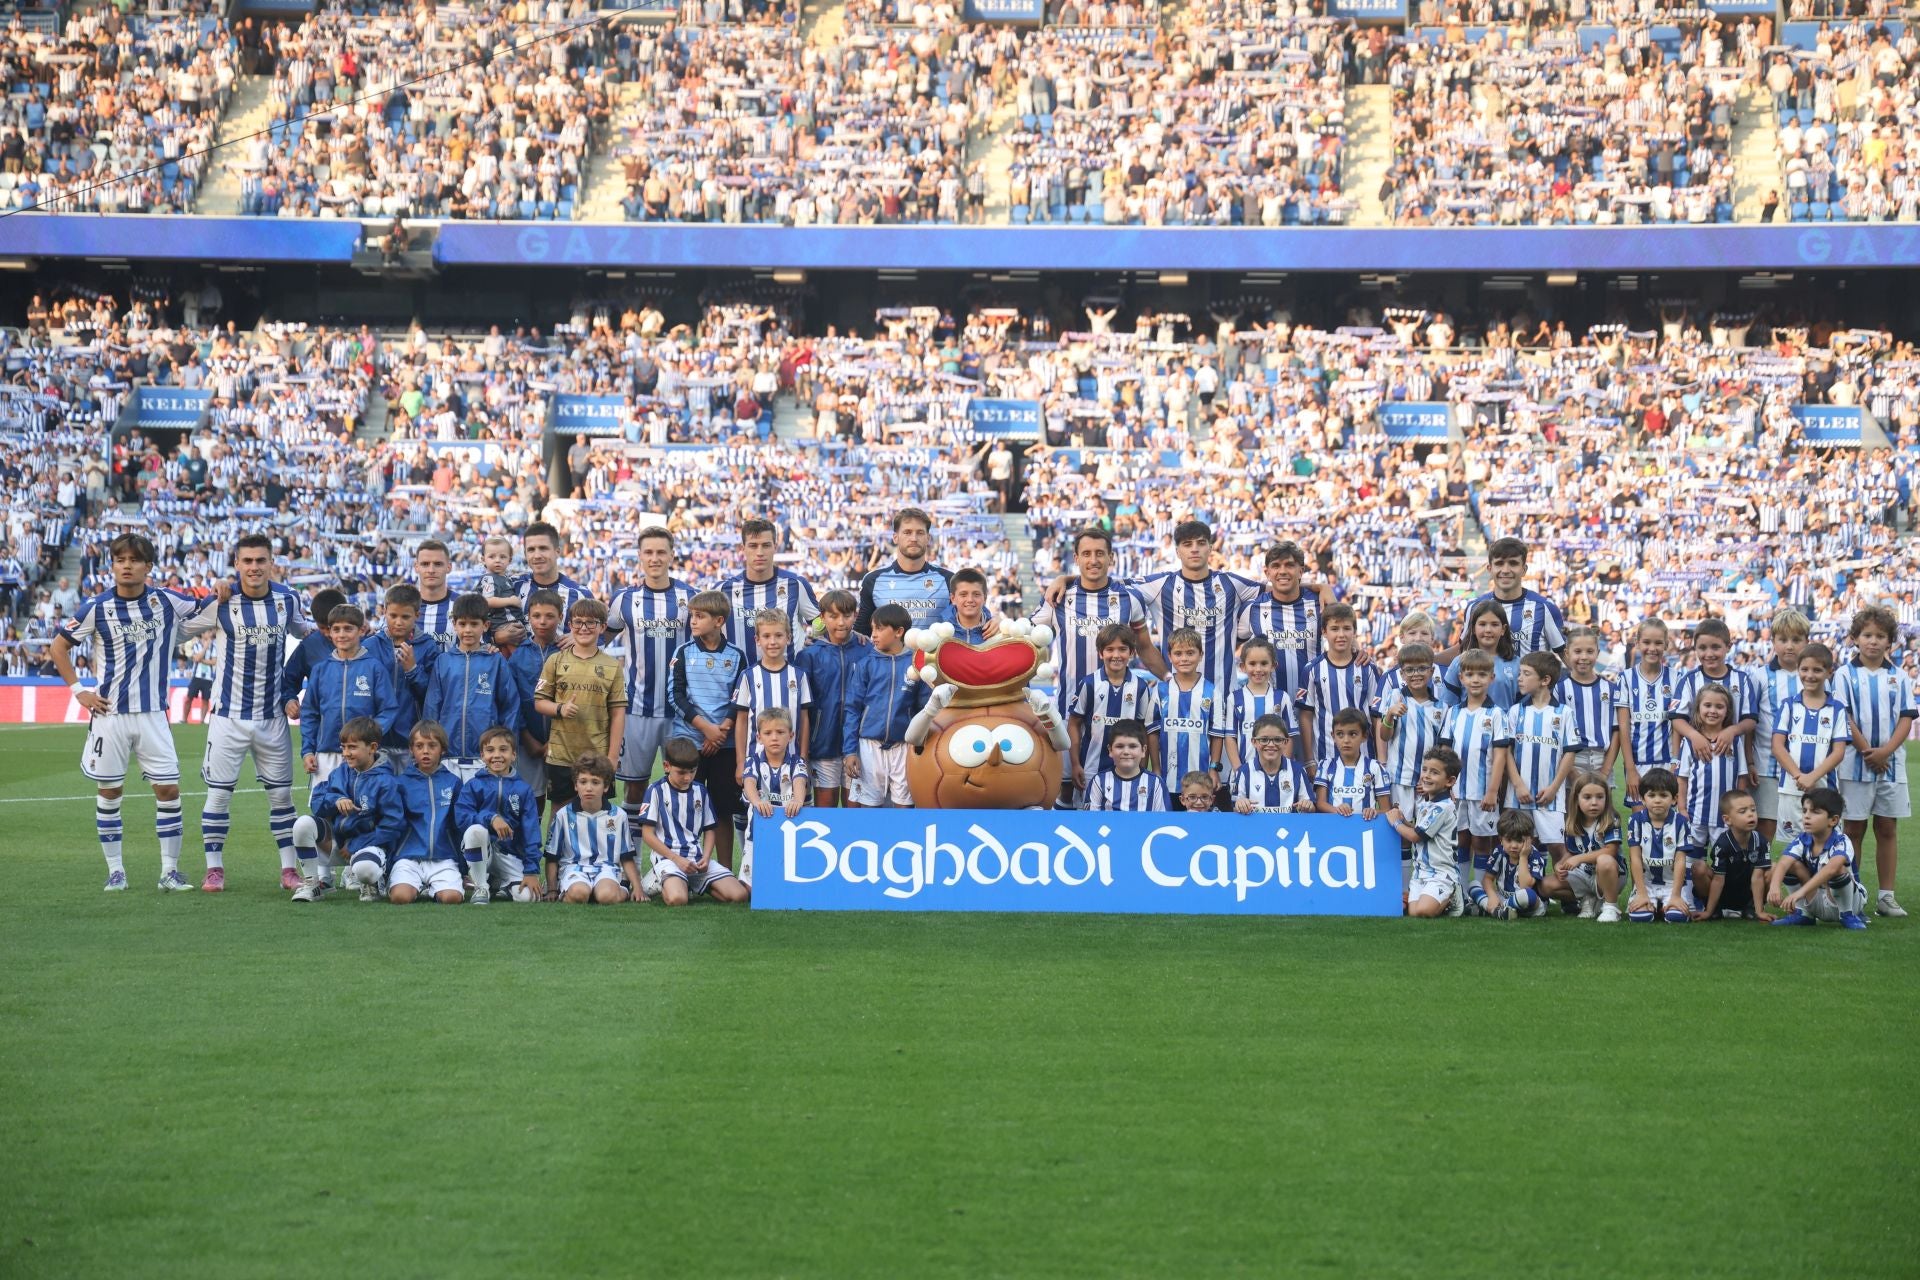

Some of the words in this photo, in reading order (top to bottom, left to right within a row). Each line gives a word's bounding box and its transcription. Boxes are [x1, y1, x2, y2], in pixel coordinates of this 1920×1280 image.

[970, 409, 1037, 422] KELER
[1799, 416, 1859, 429] ELER
[1177, 605, 1222, 616] Baghdadi
[114, 618, 162, 635] Baghdadi
[637, 618, 684, 629] Baghdadi
[238, 624, 284, 636] Baghdadi
[1266, 629, 1314, 640] Baghdadi
[571, 682, 604, 693] YASUDA
[1166, 719, 1202, 728] CAZOO
[1799, 734, 1830, 745] YASUD
[780, 821, 1114, 899] Baghdadi
[1141, 825, 1376, 902] Capital
[1645, 858, 1674, 867] YASUD
